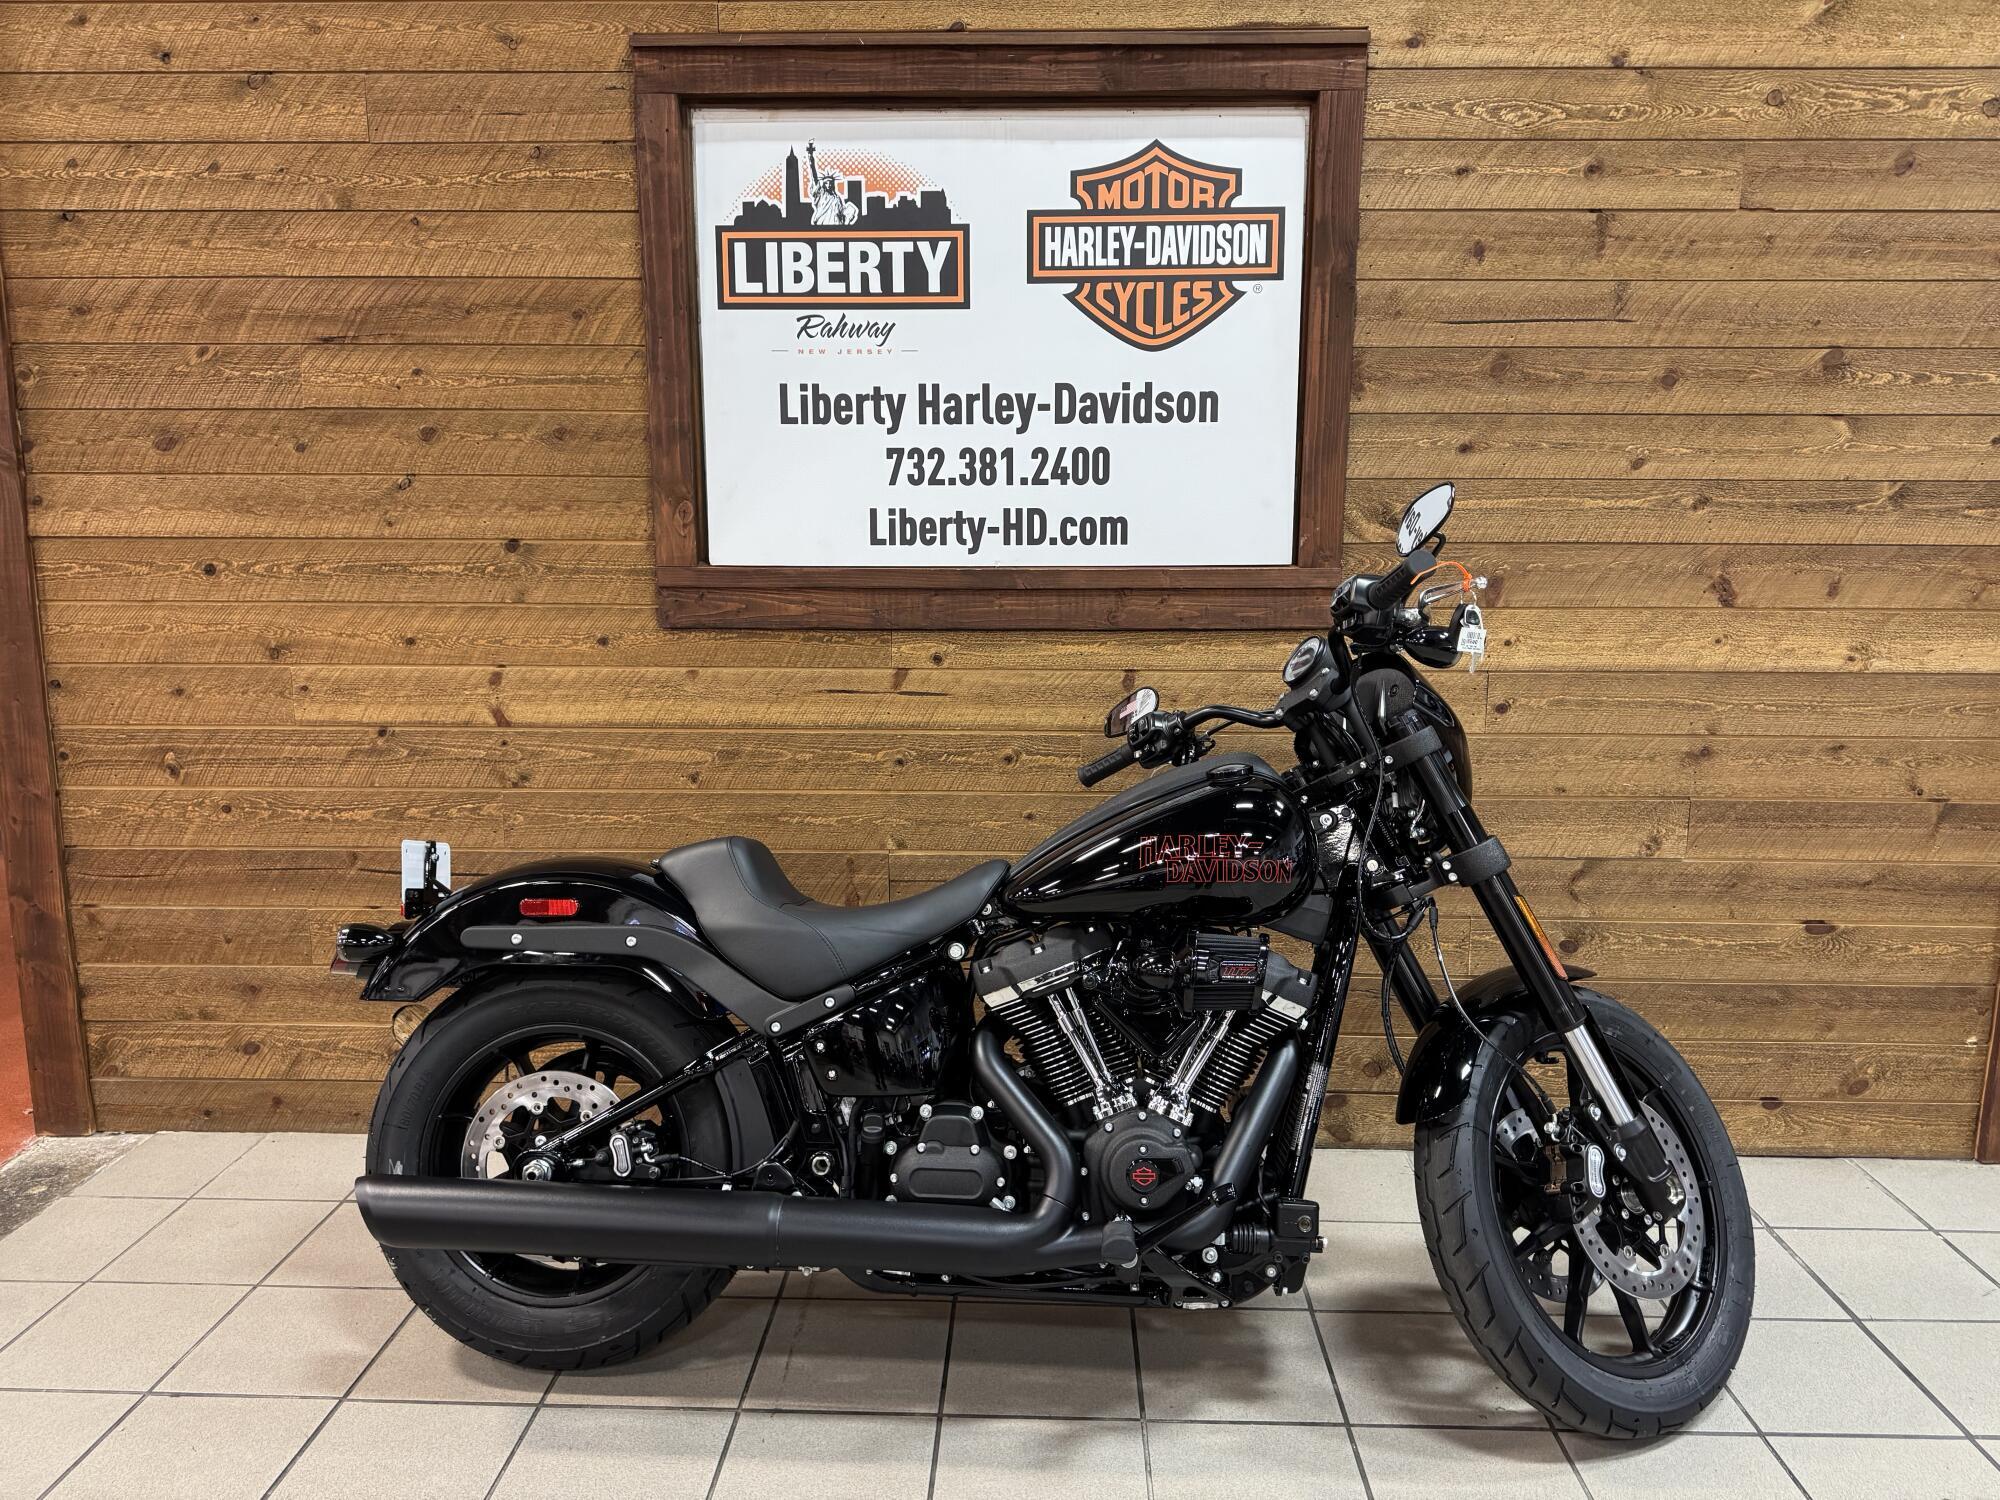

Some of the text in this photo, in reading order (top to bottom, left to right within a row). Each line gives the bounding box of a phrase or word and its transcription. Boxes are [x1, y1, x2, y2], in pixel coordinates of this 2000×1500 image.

[1098, 161, 1215, 209] MOTOR
[733, 241, 952, 294] LIBERTY
[1044, 223, 1267, 267] HARLEY-DAVIDSON
[796, 313, 896, 347] Rahway
[1096, 281, 1213, 335] CYCLES
[779, 382, 1219, 435] Liberty Harley-Davidson
[886, 447, 1111, 487] 732.381.2400
[869, 508, 1128, 555] Liberty-HD.com
[1166, 859, 1293, 883] DAVIDSON
